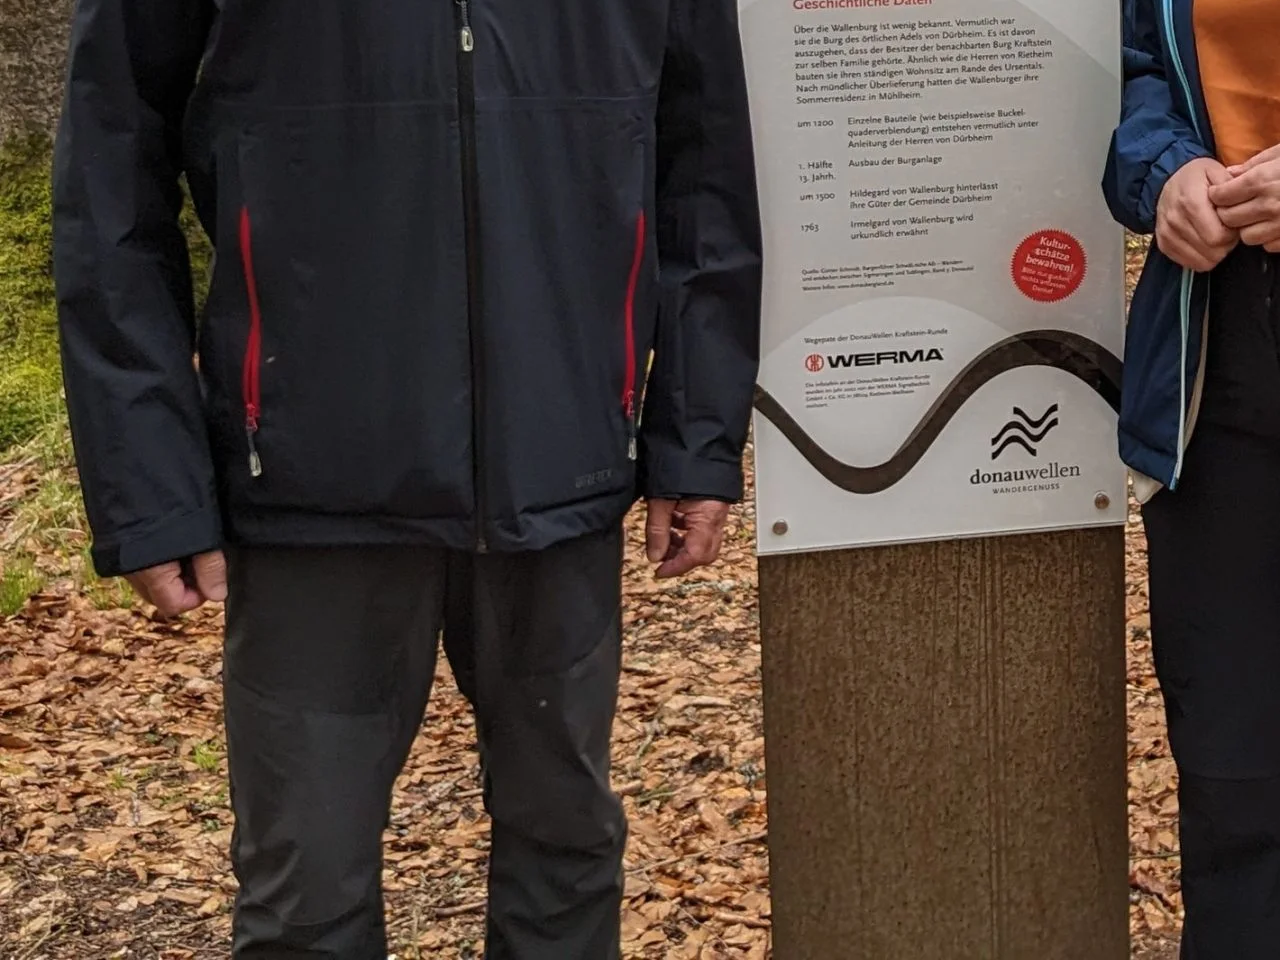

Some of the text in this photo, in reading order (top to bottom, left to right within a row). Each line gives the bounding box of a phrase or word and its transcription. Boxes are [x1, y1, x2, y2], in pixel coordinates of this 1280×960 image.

[808, 36, 821, 45] die
[823, 36, 843, 45] Burg
[844, 35, 859, 43] des
[861, 34, 898, 42] örtlichen
[899, 32, 922, 40] Adels
[942, 30, 986, 38] Dürbheim.
[1010, 27, 1035, 36] davon
[847, 116, 882, 124] Einzelne
[884, 114, 916, 123] Bauteile
[919, 114, 936, 123] (wie
[938, 111, 995, 120] beispielsweise
[847, 125, 929, 137] quaderverblendung)
[931, 123, 971, 132] entstehen
[973, 120, 1015, 129] vermutlich
[847, 140, 887, 148] Anleitung
[952, 134, 993, 142] Dürbheim
[807, 160, 832, 168] Hälfte
[880, 157, 894, 165] der
[897, 155, 942, 166] Burganlage
[811, 172, 836, 182] Jahrh.
[815, 192, 835, 201] 1500
[849, 188, 889, 198] Hildegard
[908, 185, 954, 194] Wallenburg
[956, 182, 998, 191] hinterlässt
[892, 198, 906, 206] der
[908, 196, 950, 206] Gemeinde
[952, 194, 992, 203] Dürbheim
[800, 222, 819, 232] 1763
[850, 218, 890, 229] Irmelgard
[908, 215, 954, 224] Wallenburg
[850, 228, 928, 239] urkundlich erwähnt
[1040, 236, 1071, 250] Kultur-
[1034, 248, 1070, 262] schätze
[1026, 254, 1074, 272] bewahren!
[827, 348, 944, 367] WERMA
[969, 462, 1080, 484] donauwellen
[992, 483, 1060, 493] WANDERGENUSS
